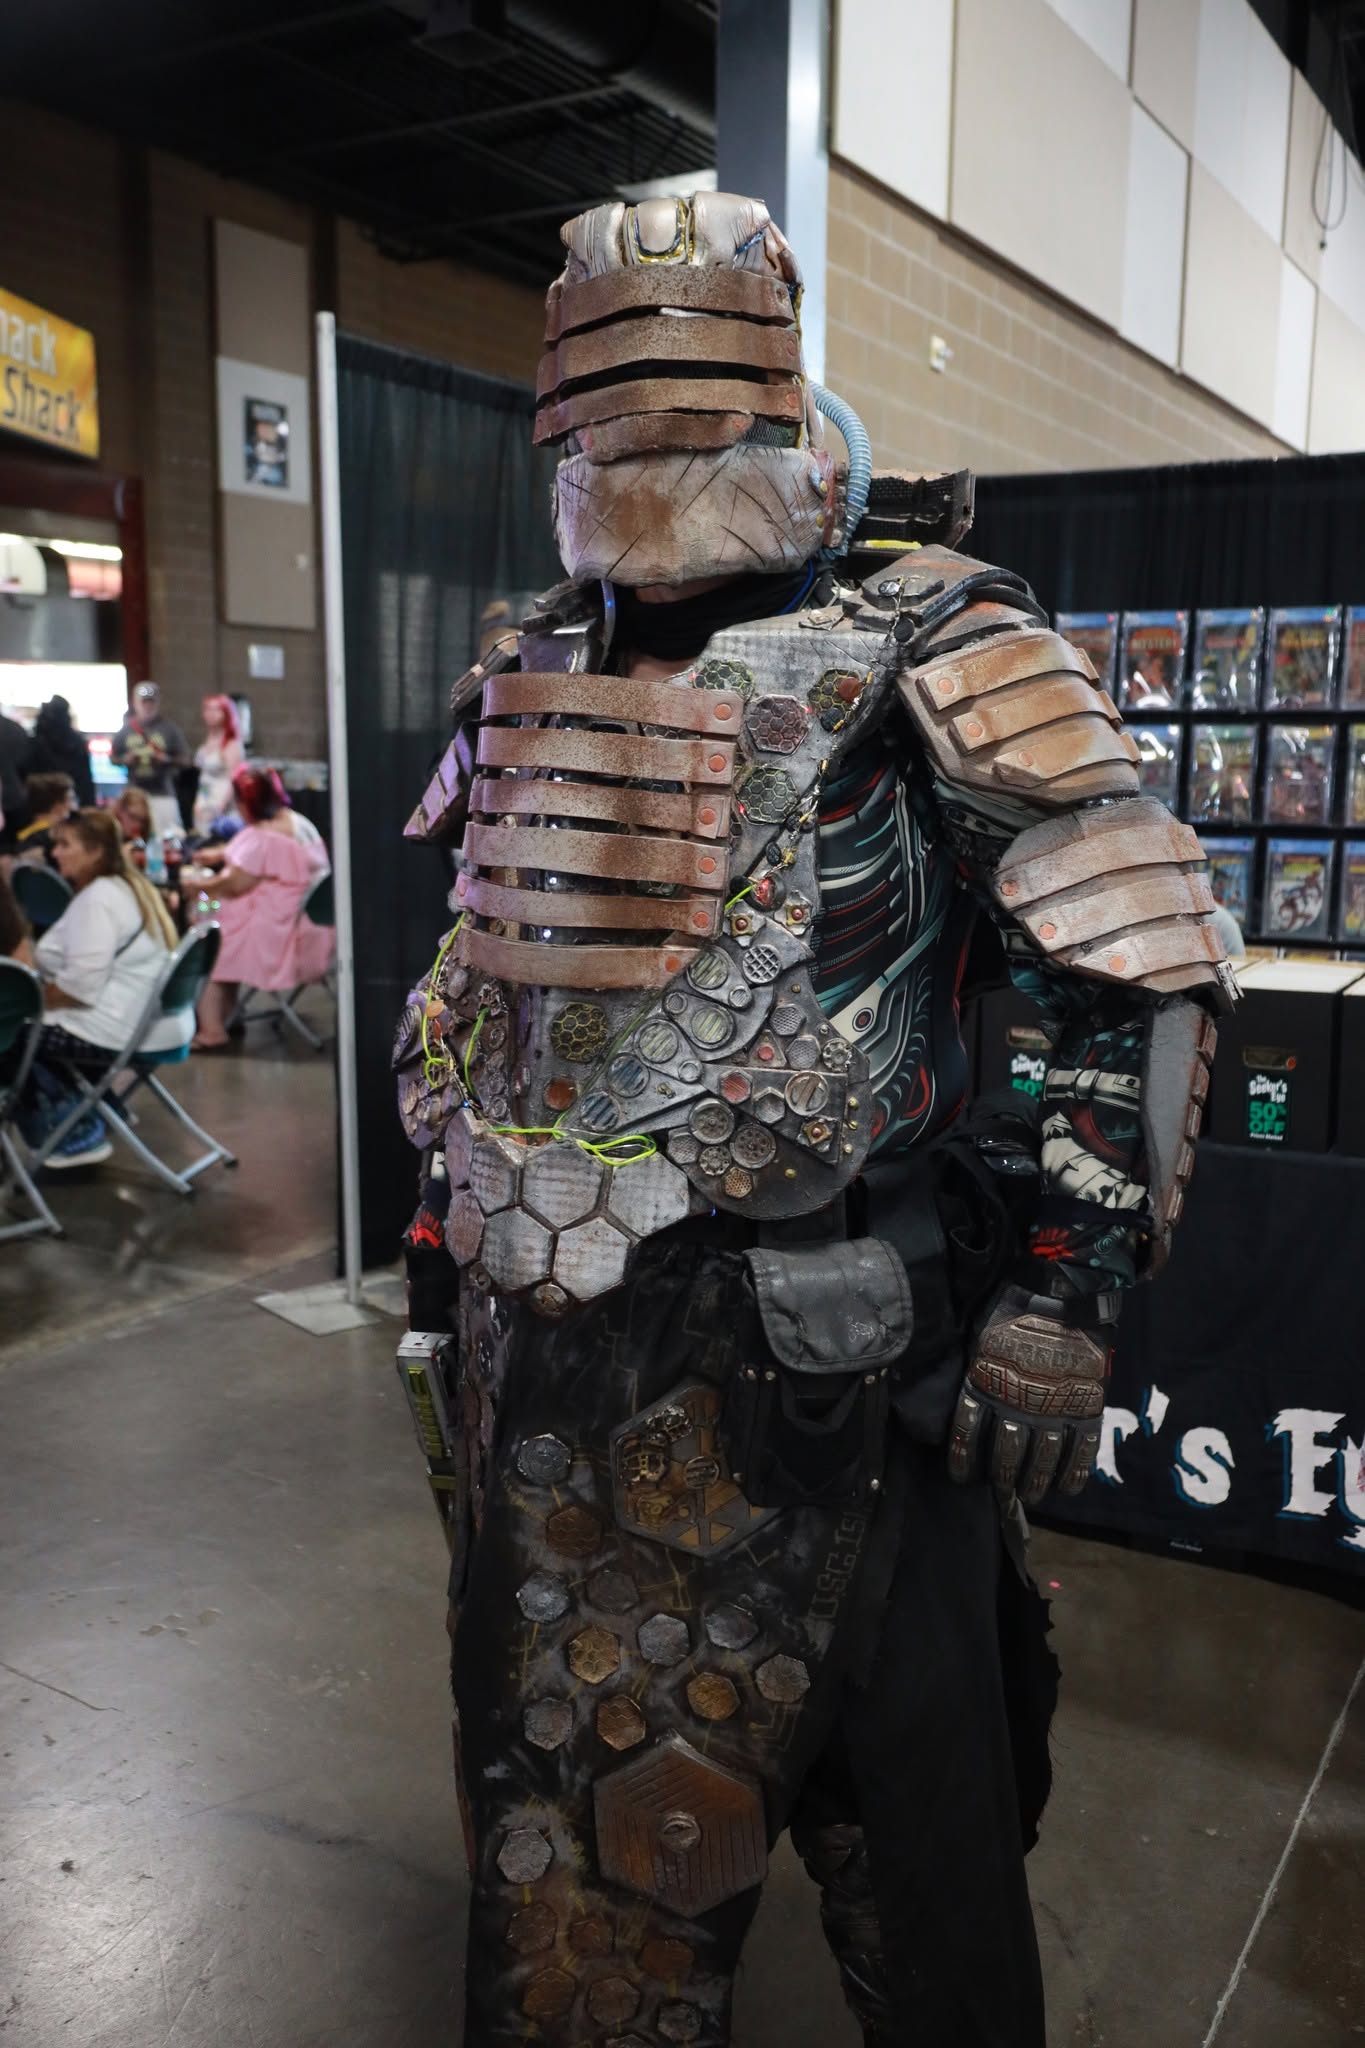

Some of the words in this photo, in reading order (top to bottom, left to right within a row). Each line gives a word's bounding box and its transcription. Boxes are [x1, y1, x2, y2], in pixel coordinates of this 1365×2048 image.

[4, 365, 81, 447] Shack
[1250, 1101, 1287, 1121] 50%
[1249, 1120, 1285, 1135] OFF
